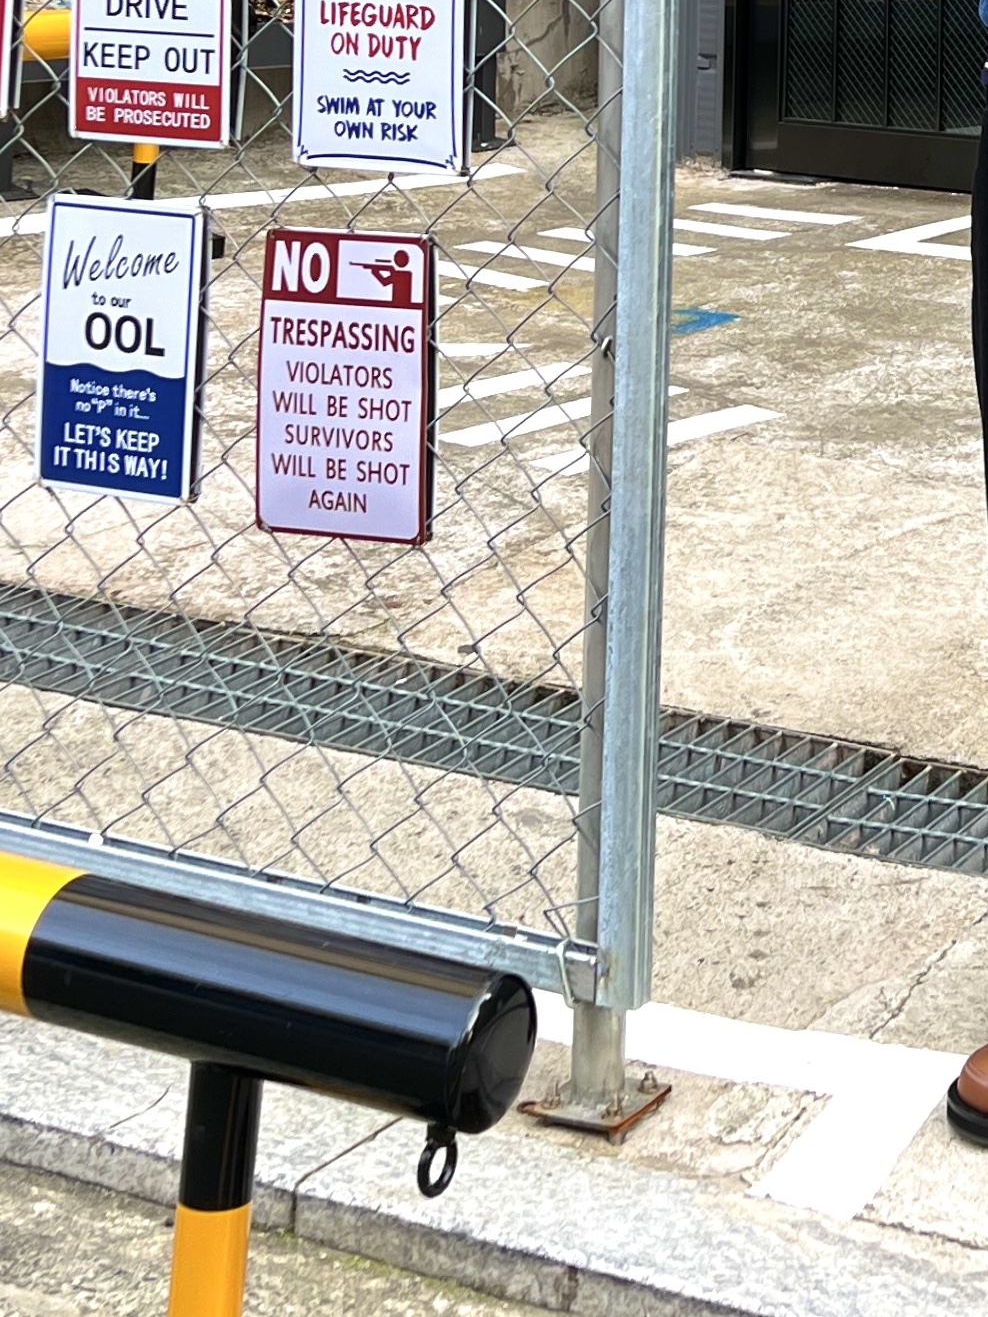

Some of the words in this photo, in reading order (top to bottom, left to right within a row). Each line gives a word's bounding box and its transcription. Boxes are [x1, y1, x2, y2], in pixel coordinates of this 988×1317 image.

[320, 0, 436, 31] LIFEGUARD
[83, 42, 150, 71] KEEP
[164, 47, 215, 75] OUT
[331, 32, 359, 56] ON
[368, 34, 422, 62] DUTY
[88, 87, 167, 107] VIOLATORS
[173, 93, 210, 110] WILL
[317, 95, 360, 118] SWIM
[366, 97, 387, 118] AT
[392, 99, 437, 119] YOUR
[86, 105, 106, 123] BE
[113, 106, 211, 129] PROSECUTED
[334, 120, 374, 140] OWN
[381, 122, 418, 142] RISK
[62, 234, 179, 290] Welcome
[271, 239, 331, 294] NO
[91, 292, 106, 307] to
[111, 294, 132, 309] our
[85, 311, 166, 357] OOL
[271, 316, 415, 353] TRESPASSING
[70, 378, 109, 396] Notice
[112, 384, 157, 402] there's
[286, 361, 393, 389] VIOLATORS
[114, 402, 126, 417] in
[273, 391, 316, 417] WILL
[327, 394, 348, 419] BE
[358, 398, 412, 422] SHOT
[64, 422, 111, 447] LET'S
[116, 427, 160, 452] KEEP
[284, 424, 393, 452] SURVIVORS
[54, 446, 72, 467] IT
[76, 448, 120, 473] THIS
[124, 453, 168, 480] WAY!
[271, 453, 316, 478] WILL
[327, 457, 347, 481] BE
[357, 460, 410, 485] SHOT
[309, 489, 367, 513] AGAIN
